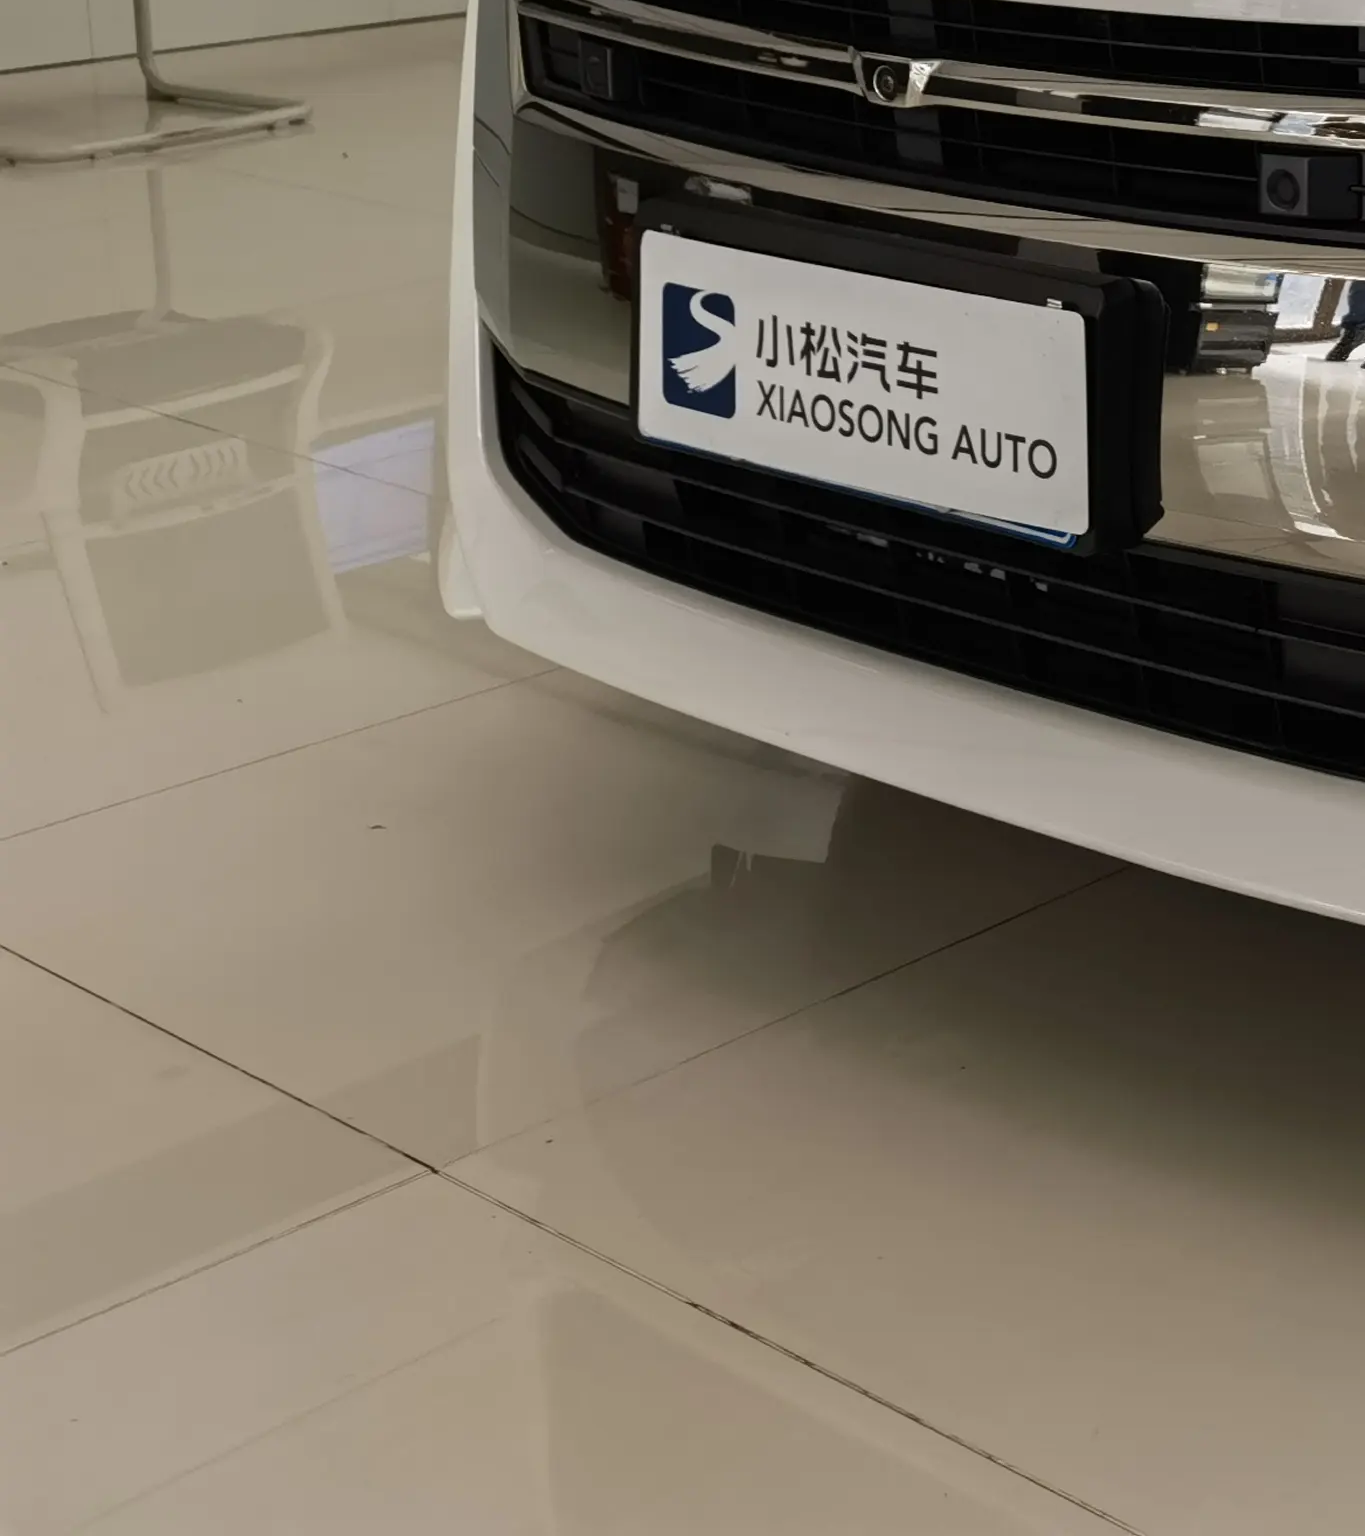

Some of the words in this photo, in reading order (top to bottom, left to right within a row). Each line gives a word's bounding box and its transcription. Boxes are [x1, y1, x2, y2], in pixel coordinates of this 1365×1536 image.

[756, 314, 938, 399] 小松汽车
[756, 380, 938, 455] XIAOSONG
[951, 424, 1057, 479] AUTO
